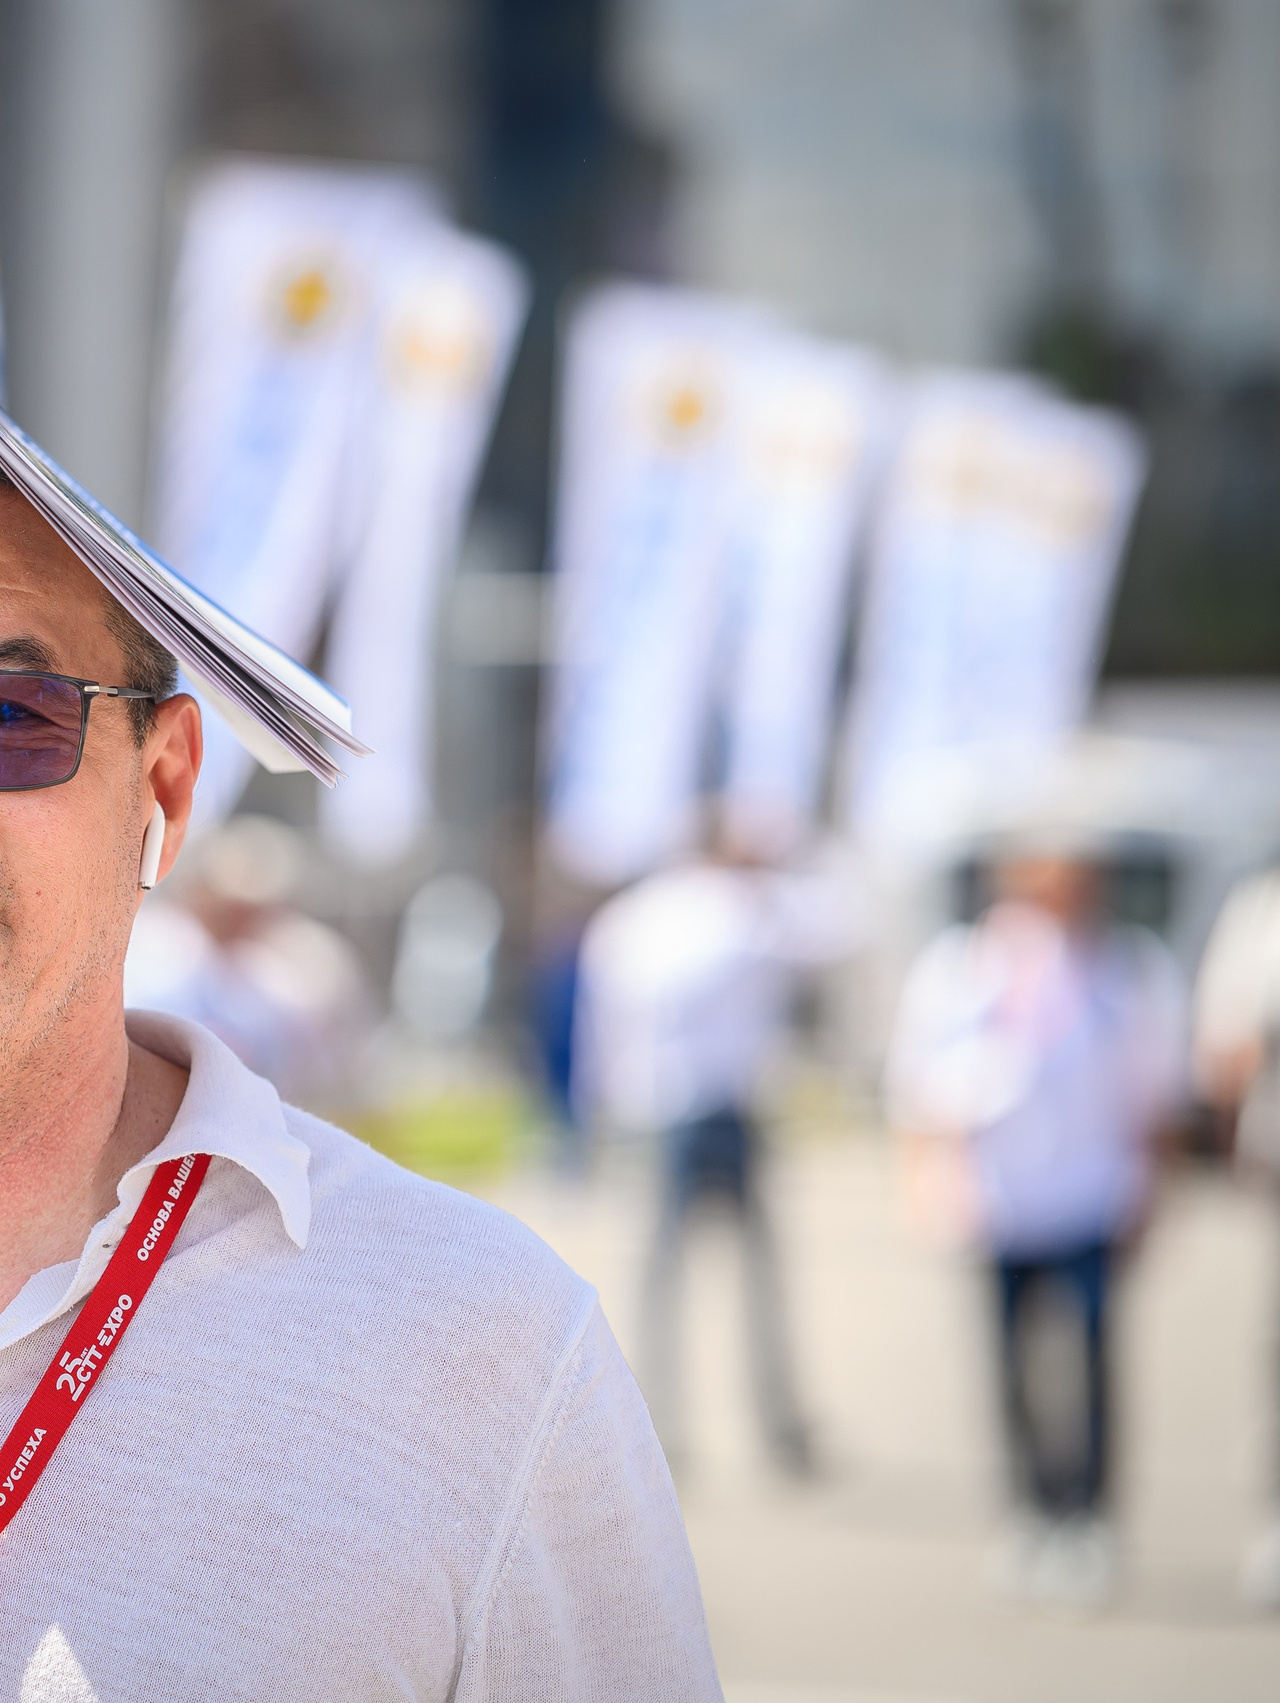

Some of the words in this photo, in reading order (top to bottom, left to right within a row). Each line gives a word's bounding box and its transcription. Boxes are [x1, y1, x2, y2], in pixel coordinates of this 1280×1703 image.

[137, 1200, 175, 1261] ОСНОВА
[55, 1350, 85, 1402] 25
[76, 1344, 103, 1383] CTT
[97, 1294, 133, 1347] EXPO
[2, 1426, 48, 1492] УСПЕХА
